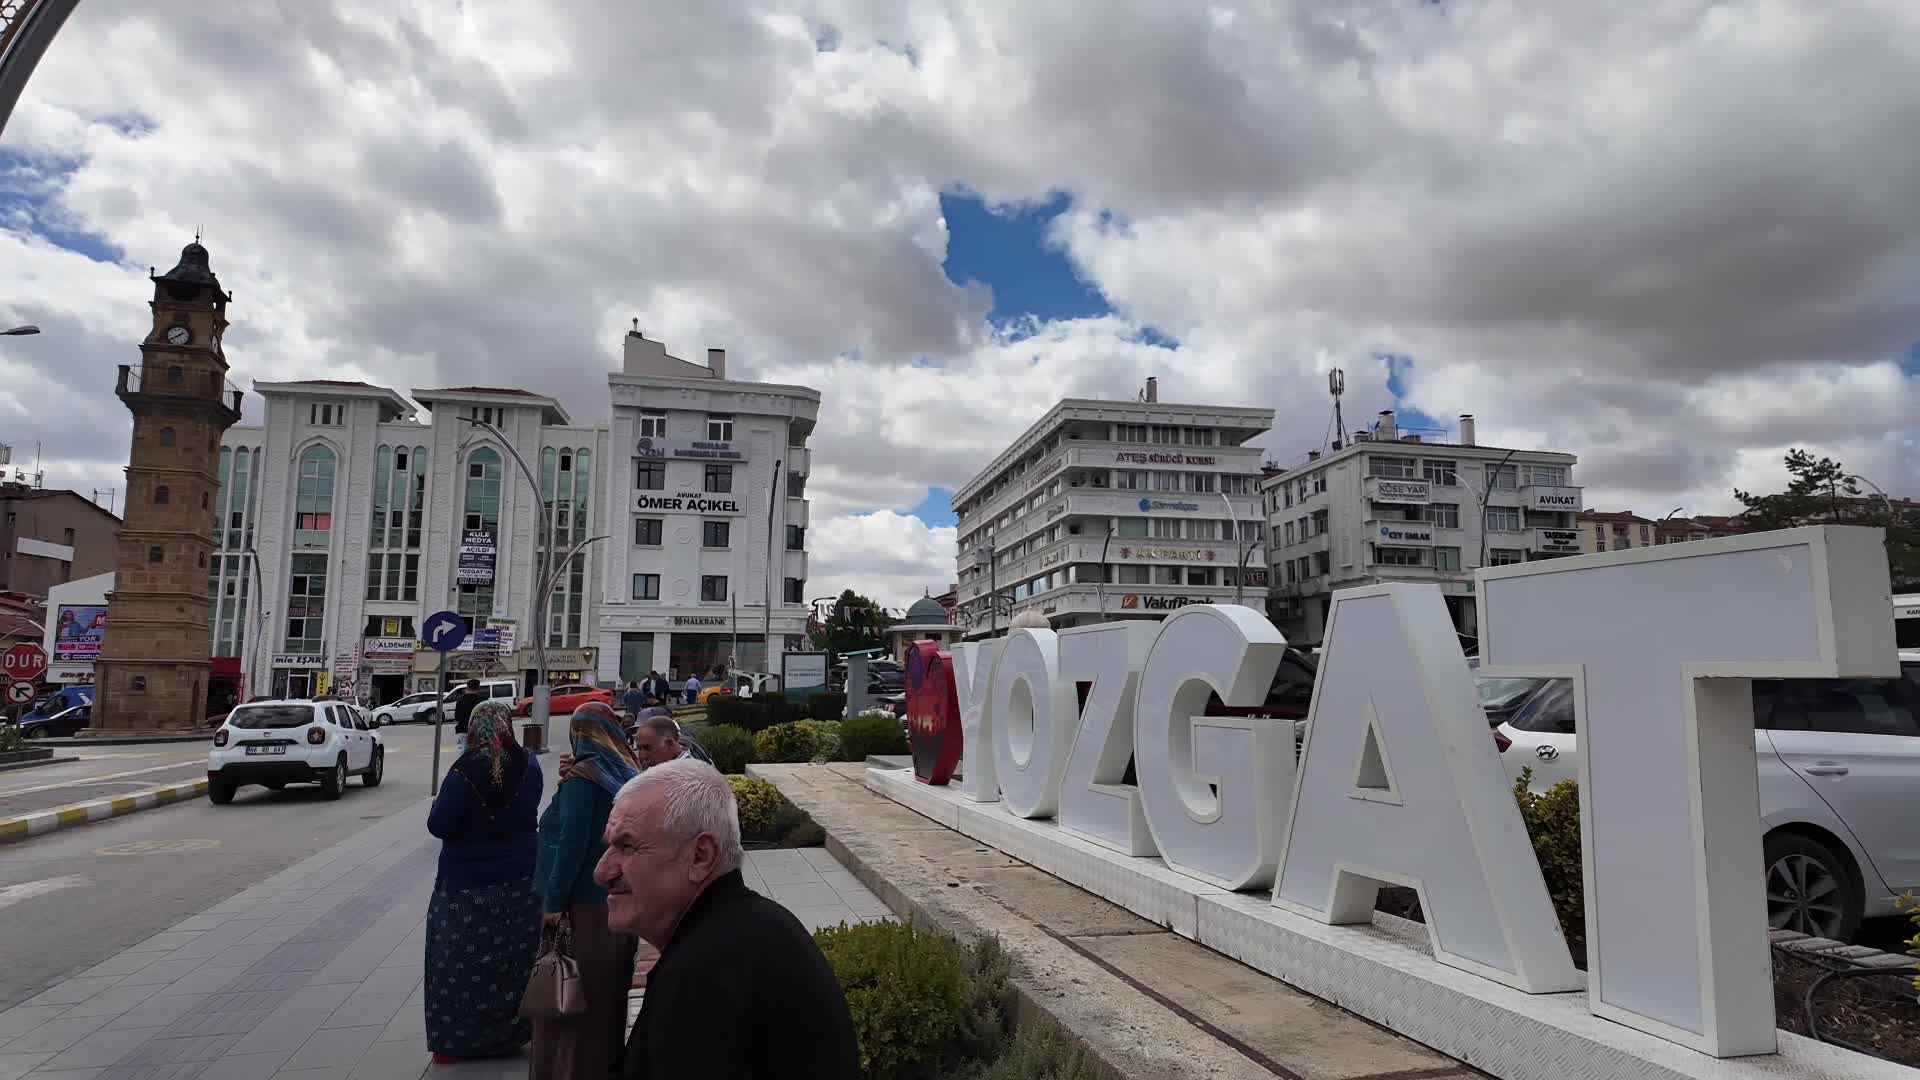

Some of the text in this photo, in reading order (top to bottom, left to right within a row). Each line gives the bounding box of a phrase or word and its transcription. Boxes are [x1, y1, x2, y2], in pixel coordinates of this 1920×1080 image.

[637, 494, 739, 513] ÖMER AÇIKEL
[1540, 495, 1575, 505] AVUKAT
[683, 617, 727, 625] HALKBANK
[378, 640, 413, 649] ALDEMİR
[5, 653, 44, 668] DUR
[950, 525, 1899, 1058] YOZGAT
